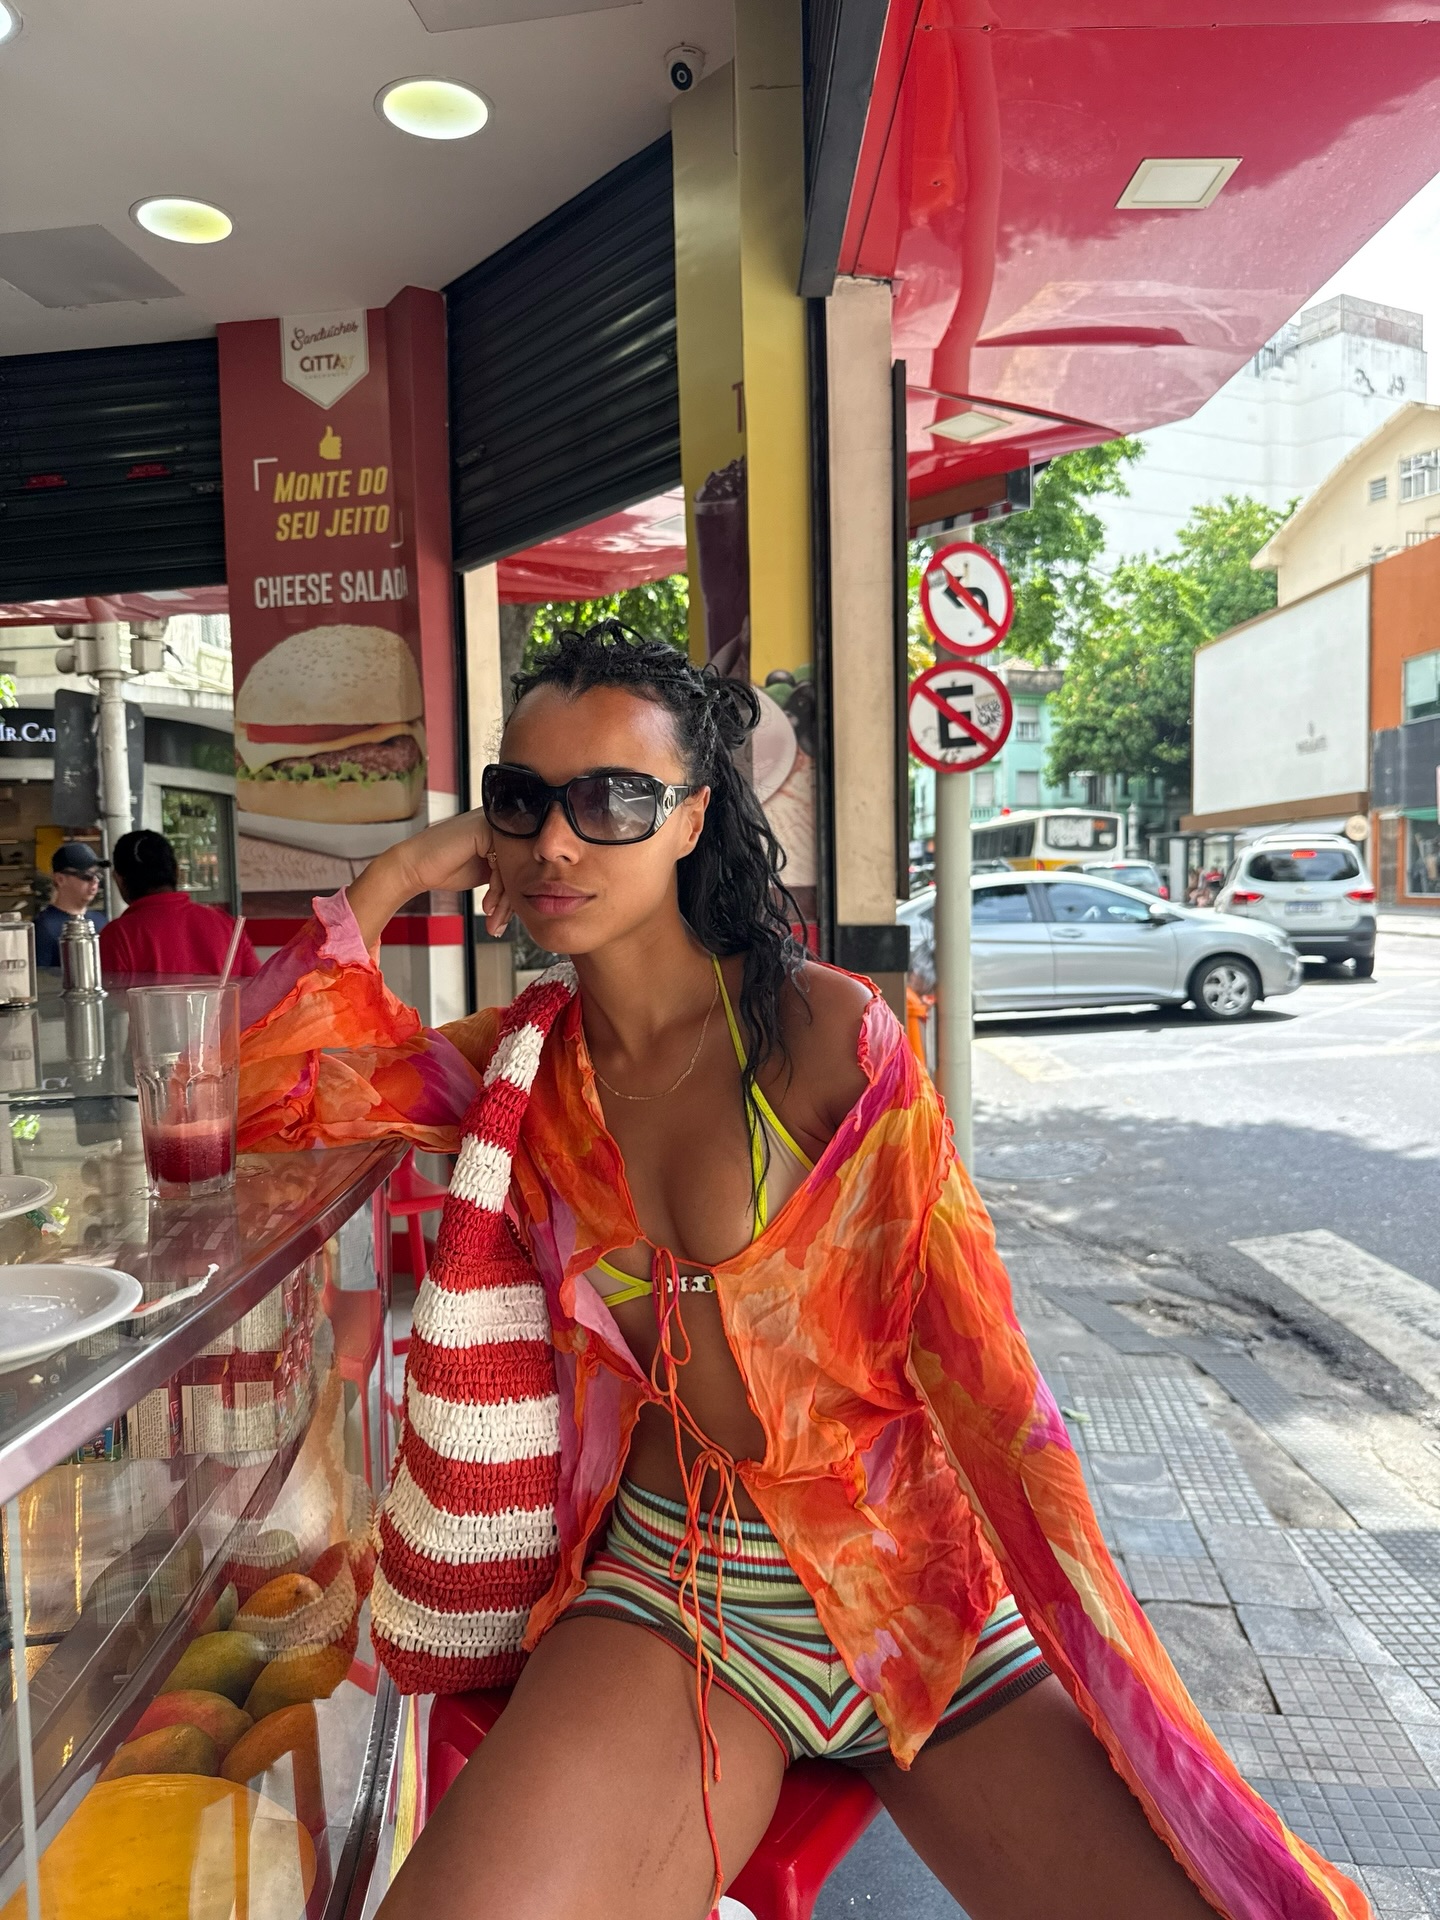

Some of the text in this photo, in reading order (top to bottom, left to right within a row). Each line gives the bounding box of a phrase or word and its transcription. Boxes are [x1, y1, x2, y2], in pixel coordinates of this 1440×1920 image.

[273, 466, 388, 503] MONTE DO
[275, 505, 390, 541] SEU JEITO
[254, 572, 334, 609] CHEESE
